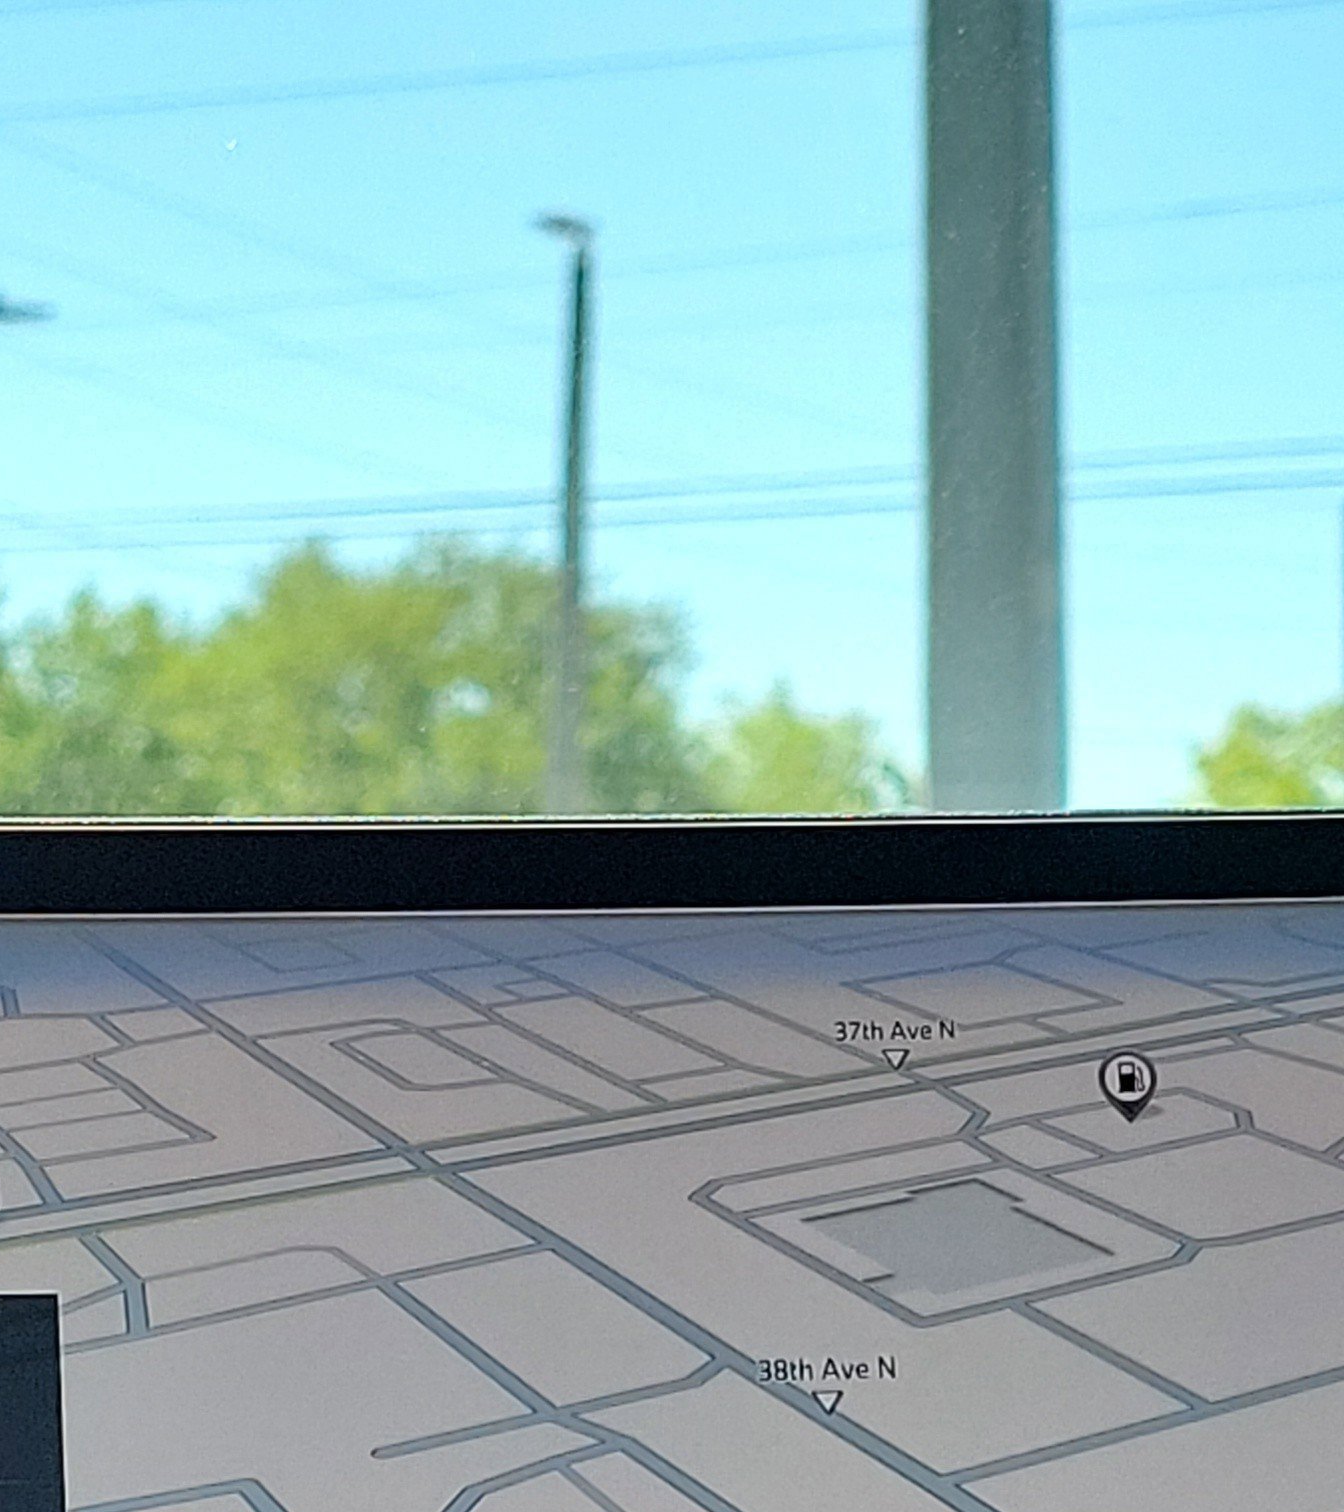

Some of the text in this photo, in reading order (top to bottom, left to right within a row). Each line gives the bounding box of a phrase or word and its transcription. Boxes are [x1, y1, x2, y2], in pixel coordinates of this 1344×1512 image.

[834, 1019, 955, 1042] 37th Ave N
[758, 1355, 896, 1381] 38th Ave N
